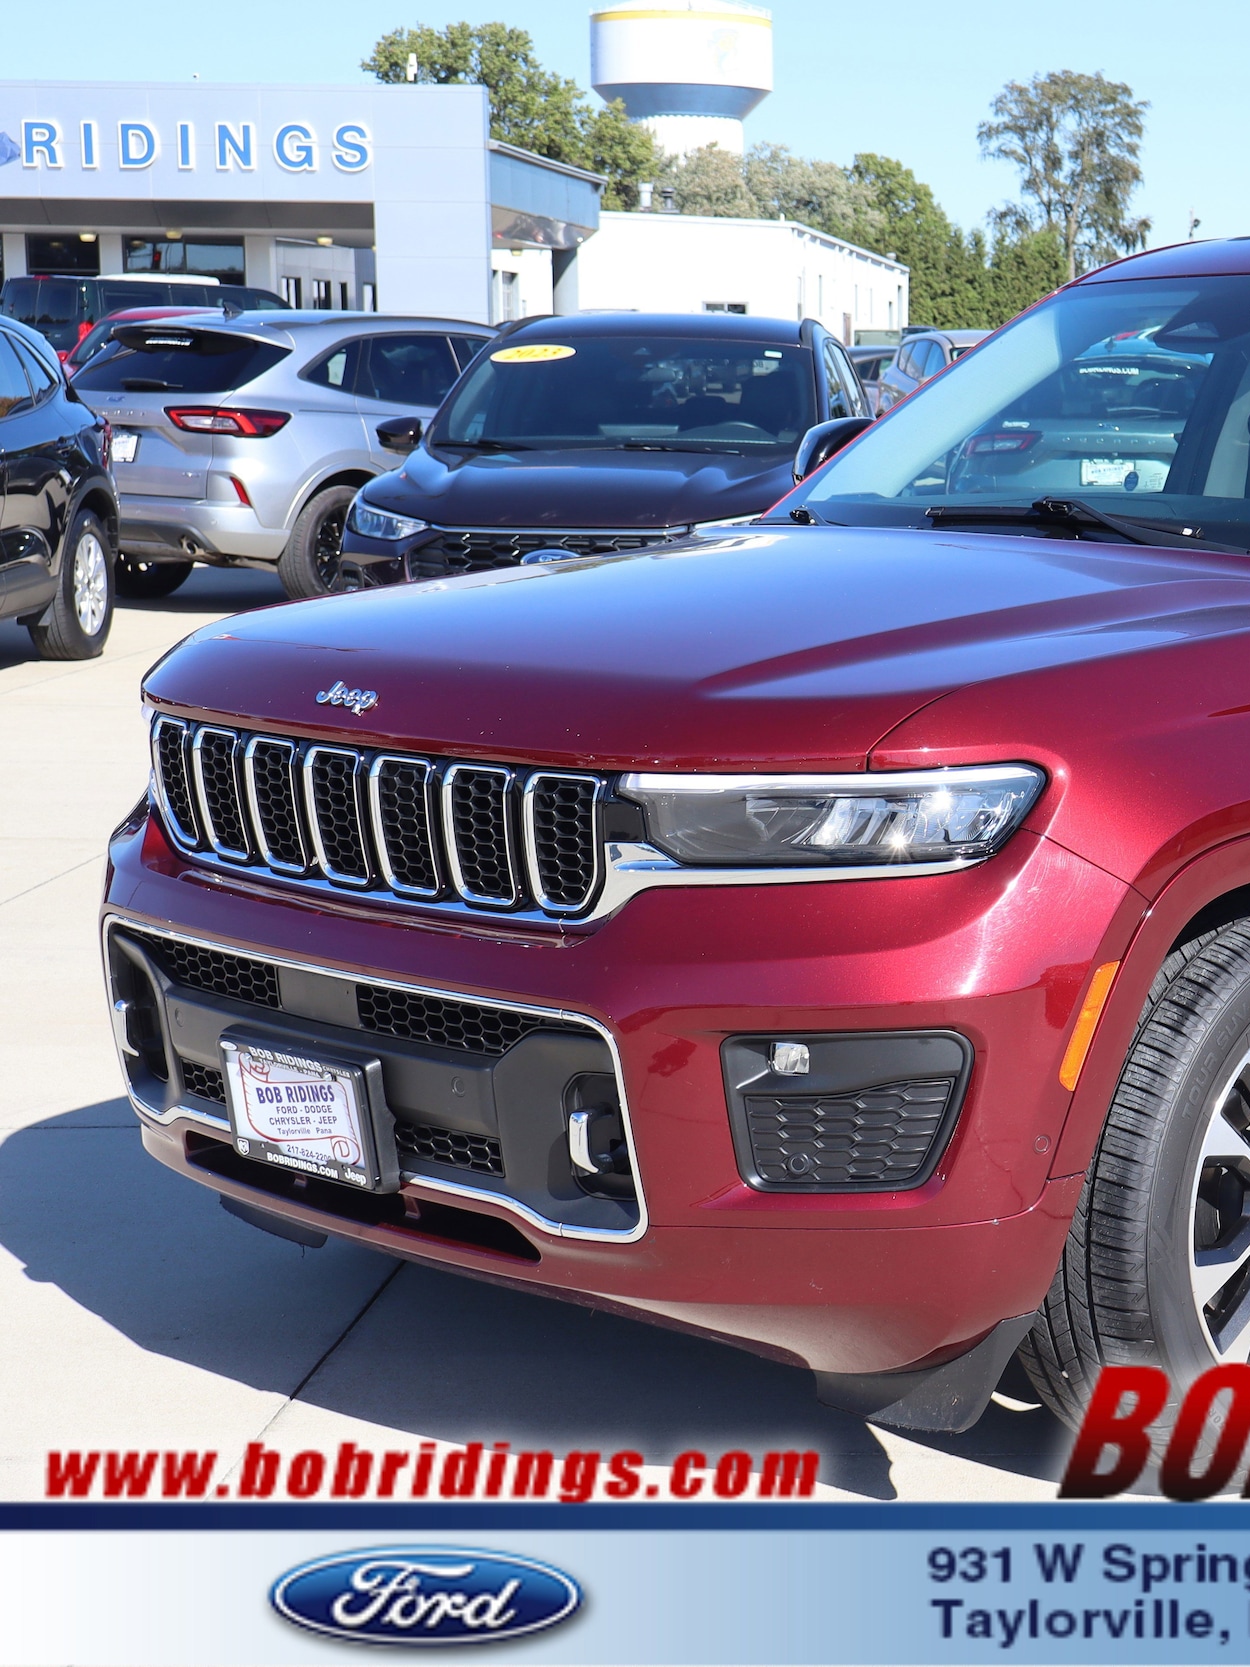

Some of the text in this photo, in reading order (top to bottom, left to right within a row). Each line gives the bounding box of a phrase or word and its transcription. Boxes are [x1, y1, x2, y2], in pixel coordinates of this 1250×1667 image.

[21, 119, 373, 173] RIDINGS
[315, 680, 378, 714] Jeep
[248, 1046, 275, 1061] BOB
[275, 1052, 323, 1073] RIDINGS
[256, 1084, 335, 1104] BOB RIDINGS
[276, 1105, 299, 1114] FORD
[304, 1104, 333, 1114] DODGE
[269, 1116, 312, 1126] CHRYSLER
[318, 1116, 338, 1126] JEEP
[277, 1127, 333, 1137] Taylorville Pana
[266, 1151, 367, 1186] BOBRIDINGS.COM Jeep
